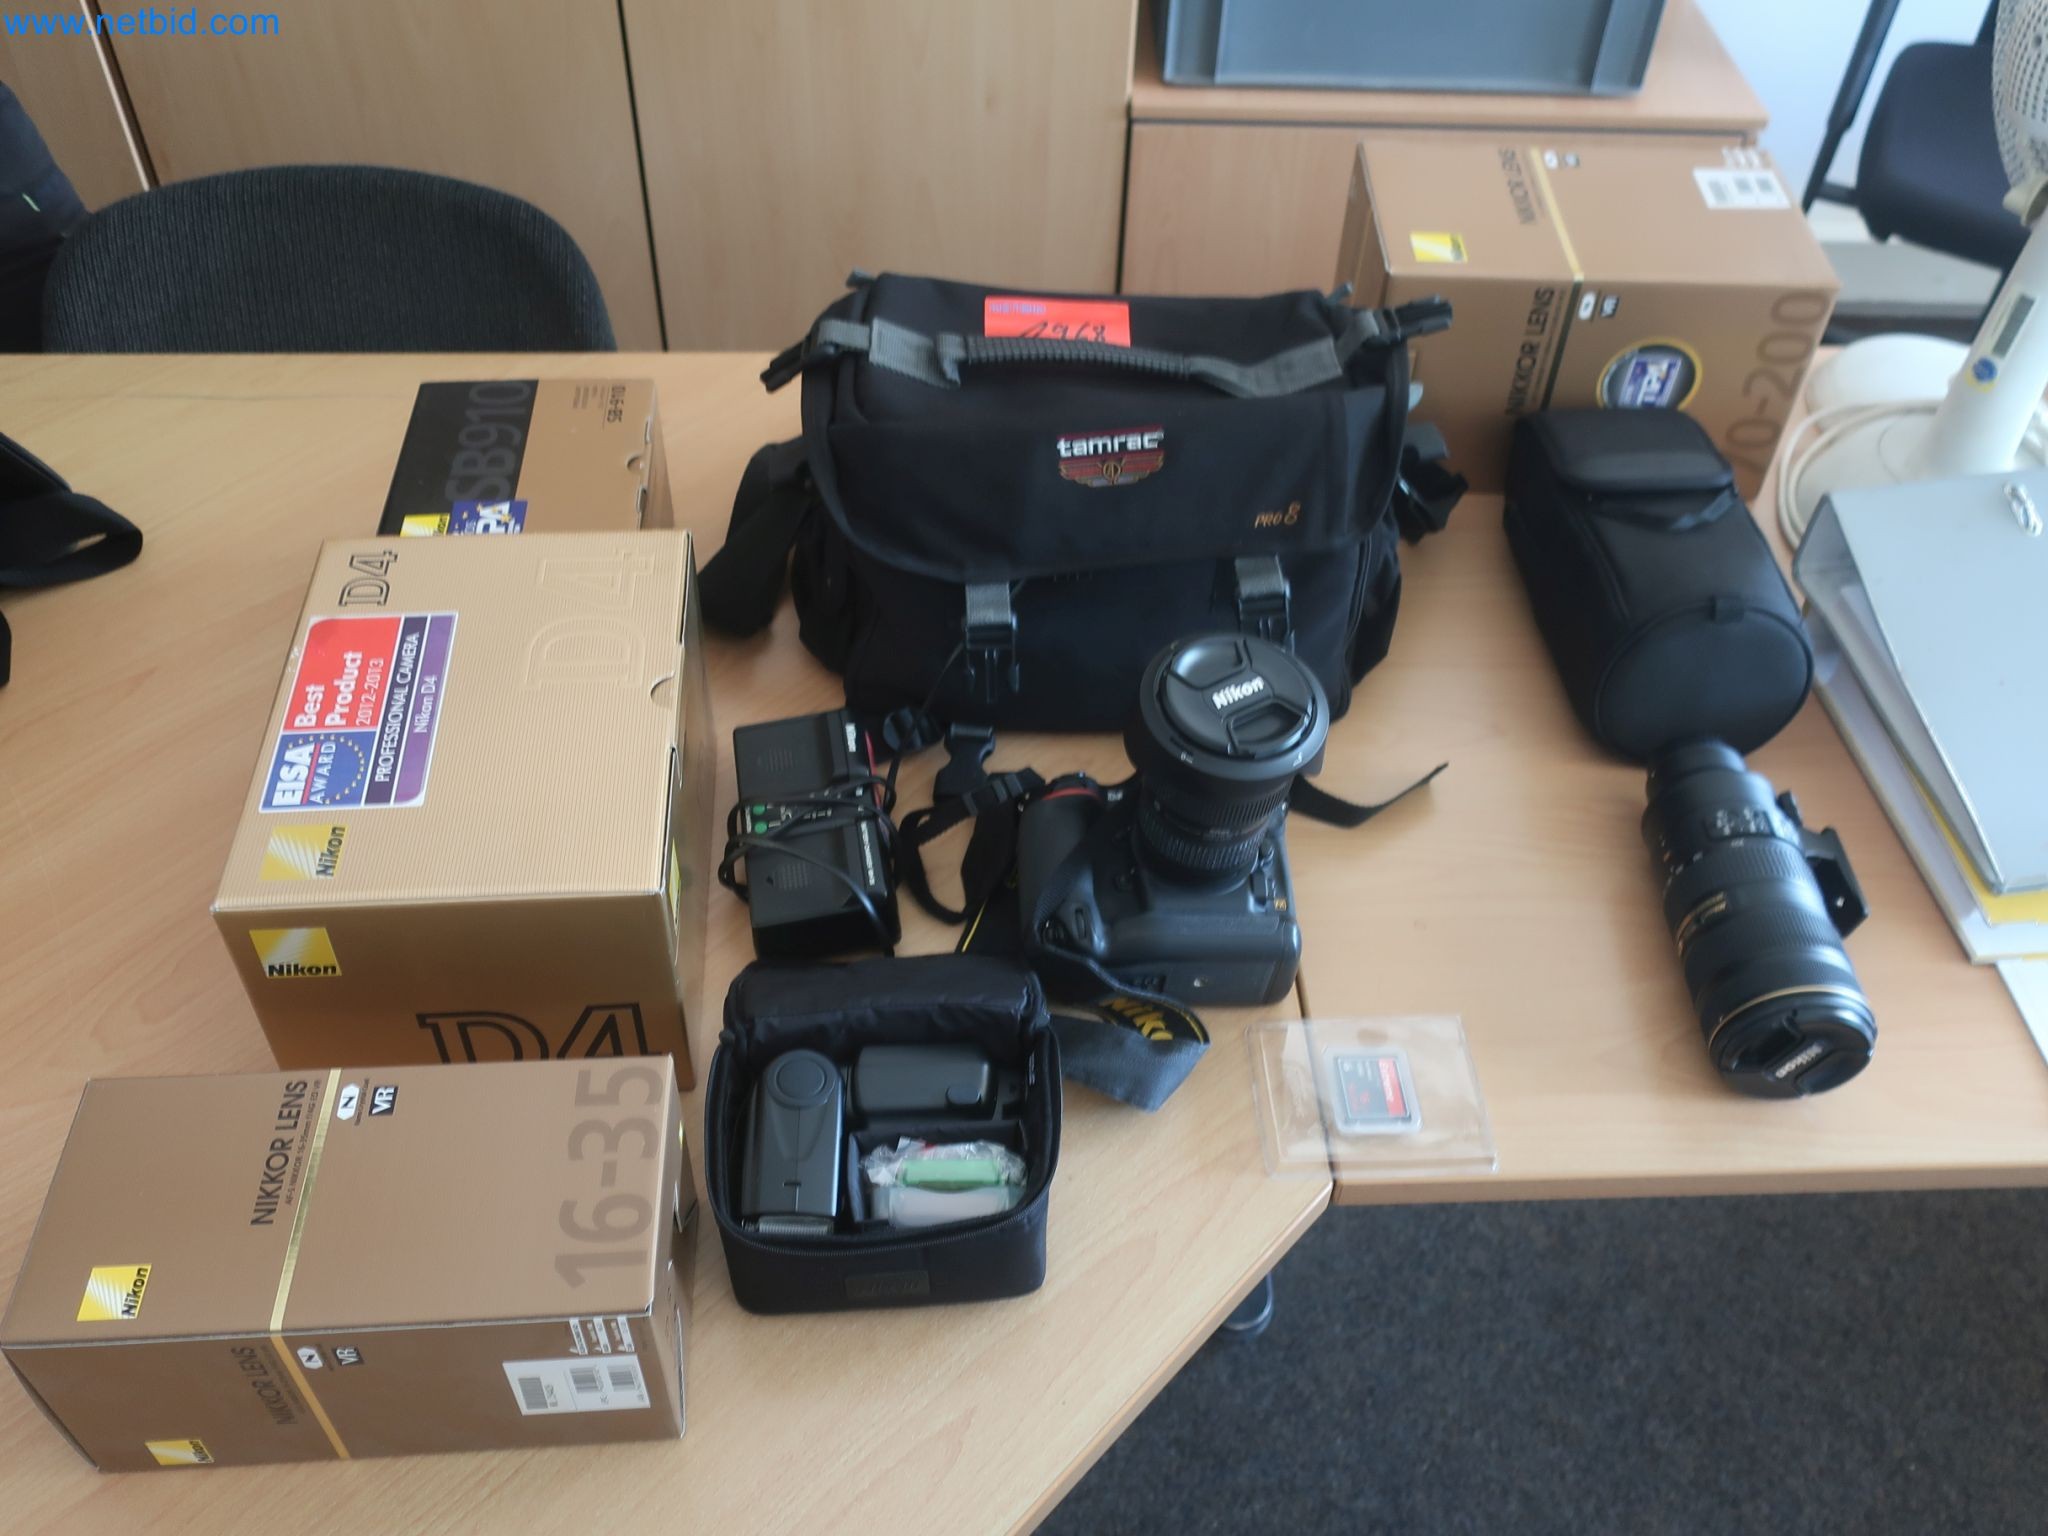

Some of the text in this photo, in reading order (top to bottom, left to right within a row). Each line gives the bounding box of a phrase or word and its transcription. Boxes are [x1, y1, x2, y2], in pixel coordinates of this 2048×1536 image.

[1056, 429, 1165, 458] tamrac
[338, 549, 398, 607] D4
[294, 683, 326, 728] Best
[325, 650, 363, 726] Product
[356, 658, 384, 727] 2012-2013
[375, 632, 420, 782] PROFESSIONAL CAMERA
[413, 674, 438, 733] Nikon D4
[1212, 676, 1265, 710] Nikon
[272, 743, 316, 806] EISA
[308, 741, 337, 805] AWARD
[316, 826, 346, 878] Nikon
[268, 962, 338, 978] Nikon
[416, 1003, 662, 1065] D4
[371, 1086, 396, 1115] VR
[250, 1080, 308, 1225] NIKKOR LENS
[554, 1066, 664, 1289] 16-35
[121, 1267, 149, 1317] Nikon
